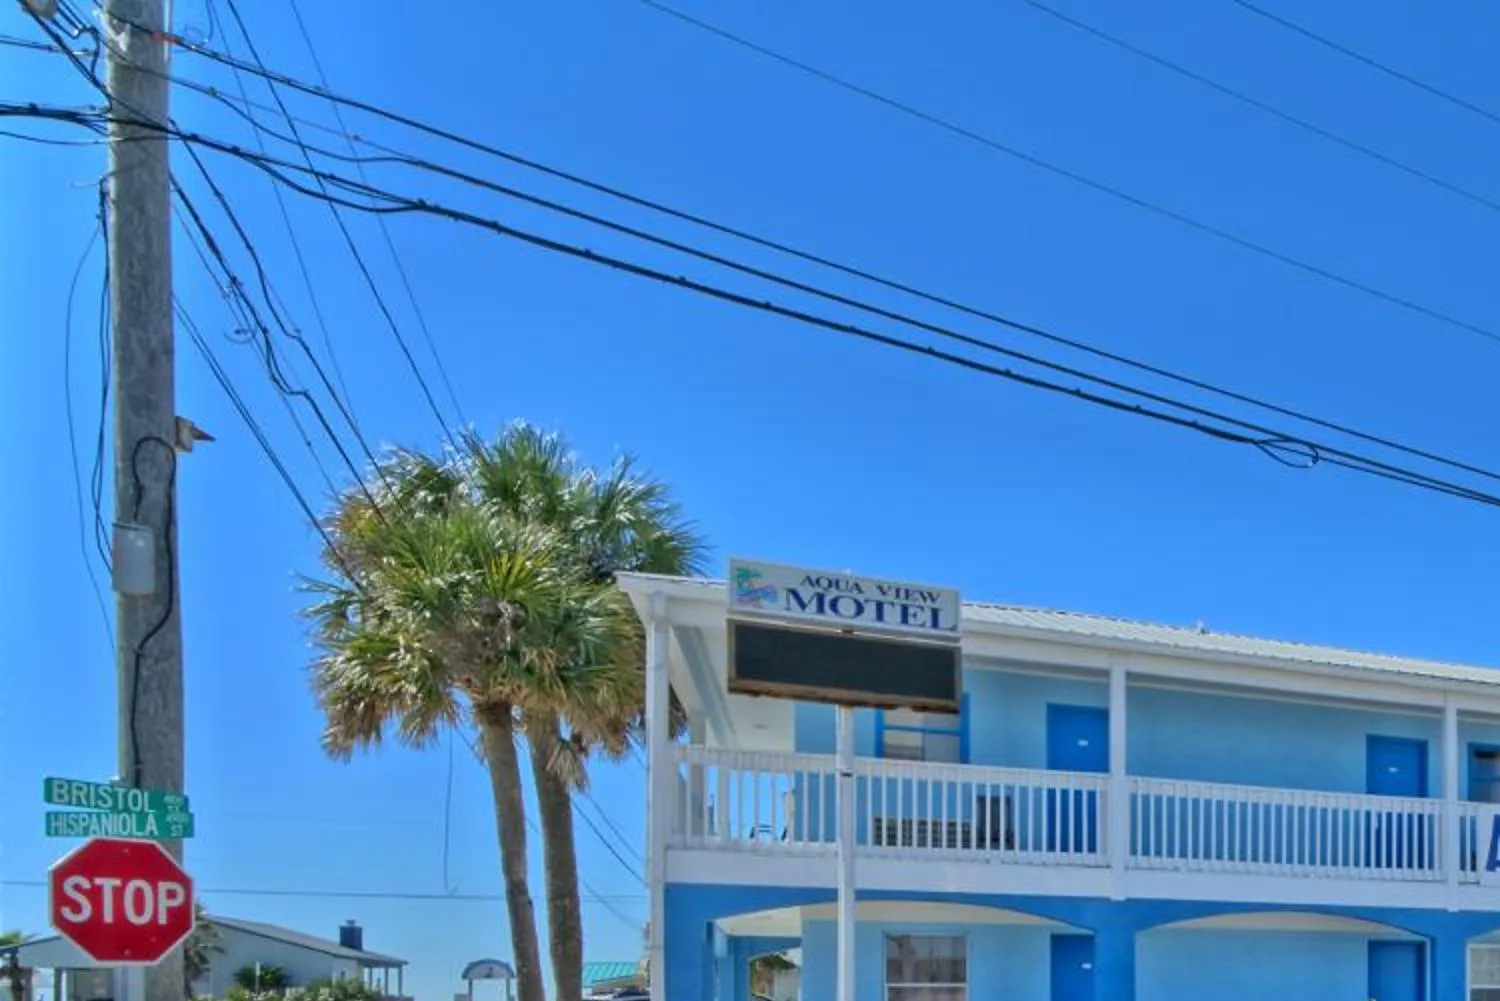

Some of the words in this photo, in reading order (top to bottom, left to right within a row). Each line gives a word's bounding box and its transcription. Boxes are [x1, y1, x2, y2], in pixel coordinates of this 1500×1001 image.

[800, 574, 864, 595] AQUA
[875, 584, 942, 603] VIEW
[783, 587, 958, 631] MOTEL
[52, 779, 156, 813] BRISTOL
[49, 811, 158, 837] HISPANIOLA
[60, 874, 186, 926] STOP
